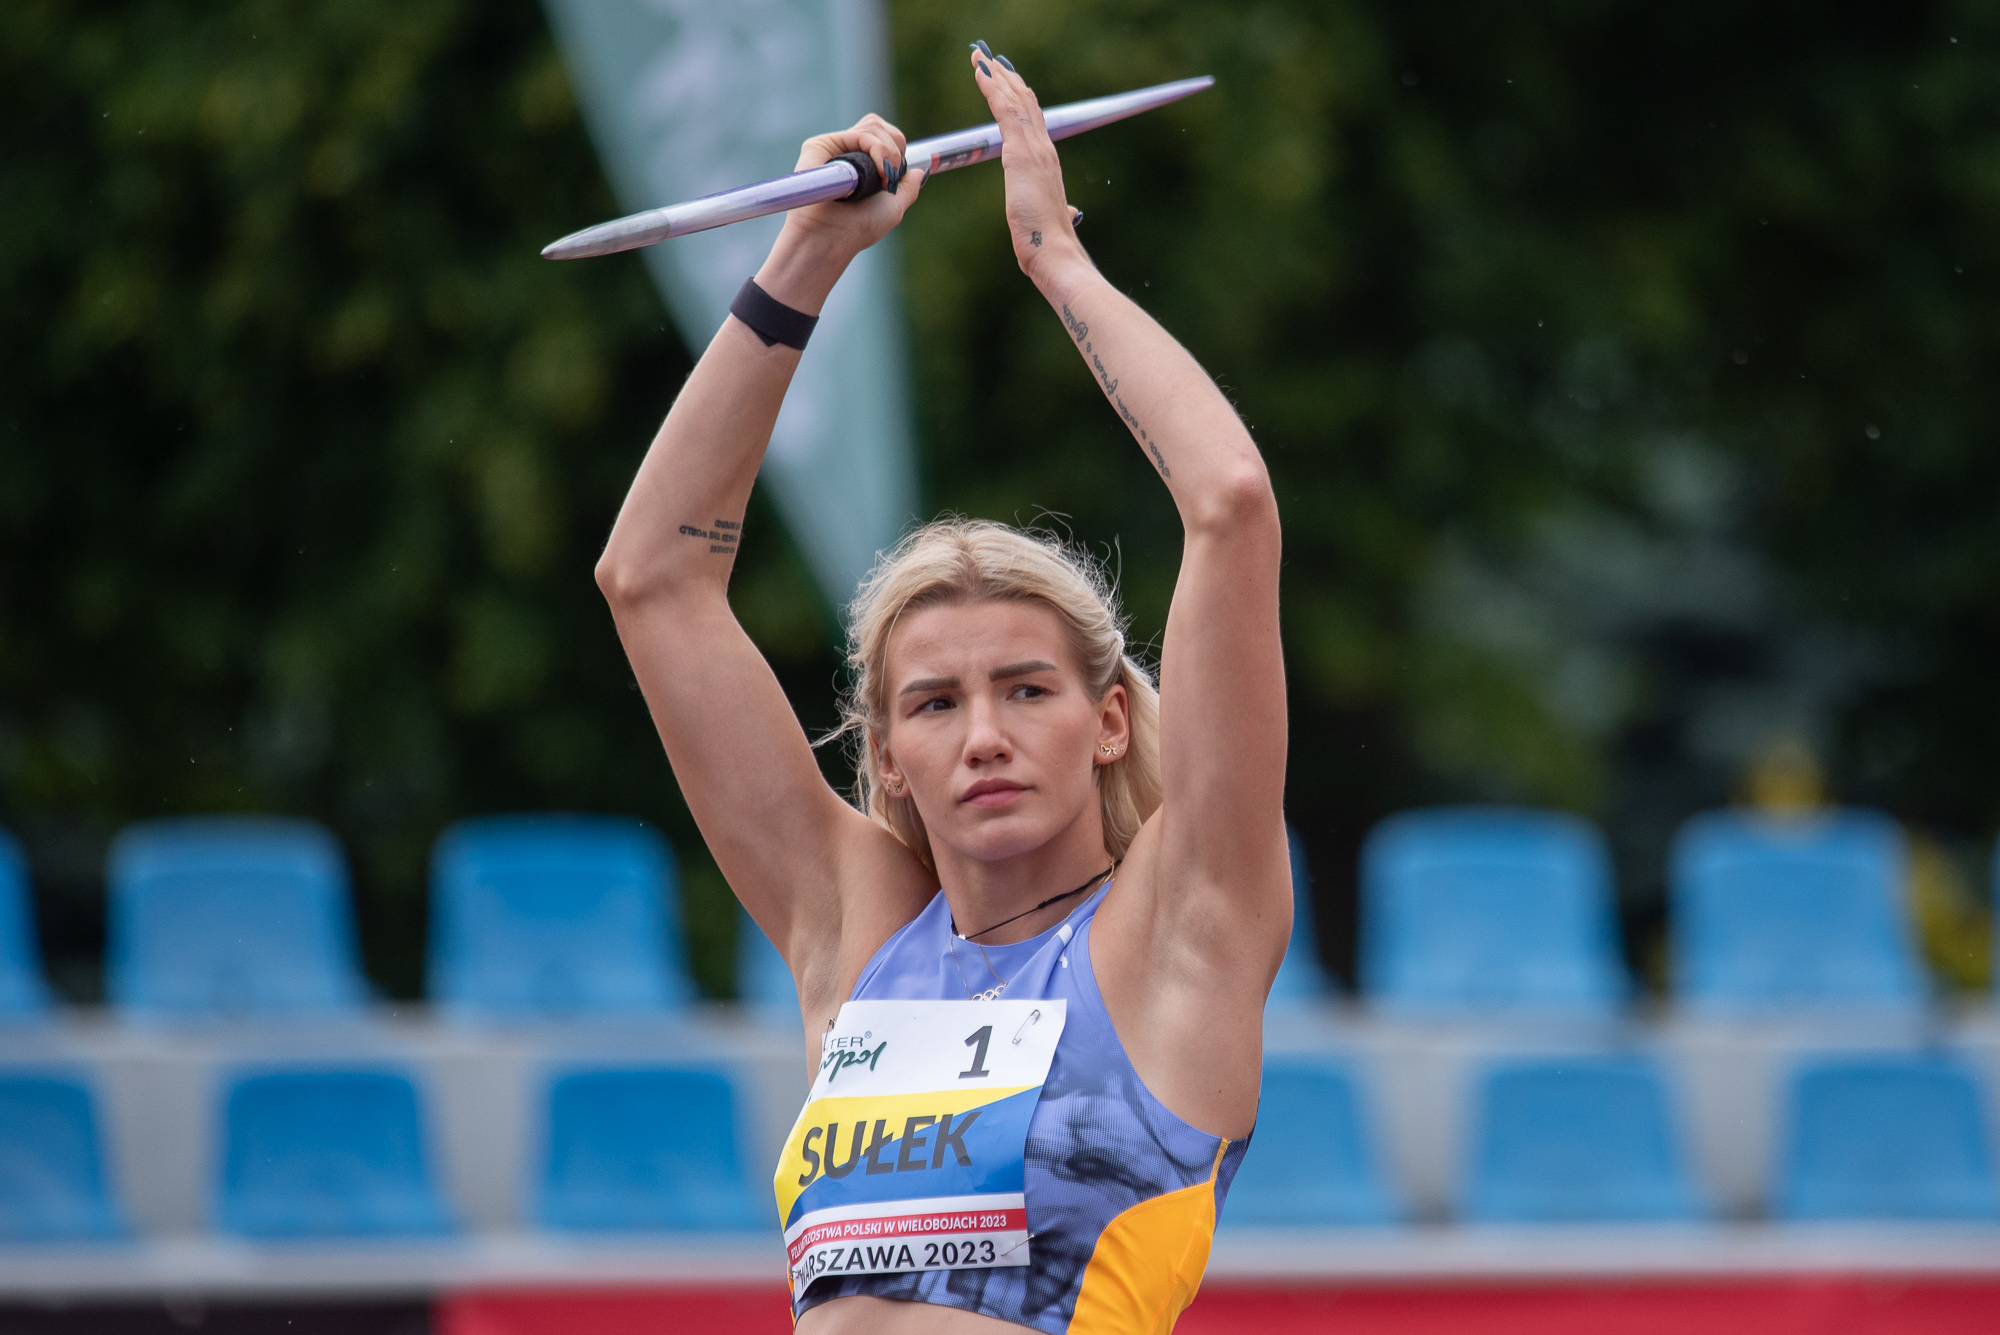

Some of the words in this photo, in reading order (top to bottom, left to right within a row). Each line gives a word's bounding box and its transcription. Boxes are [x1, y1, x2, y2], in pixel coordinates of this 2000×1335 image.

[679, 525, 708, 539] WORLD
[830, 1036, 863, 1049] TER
[958, 1025, 993, 1079] 1
[798, 1111, 982, 1188] SUŁEK
[844, 1222, 881, 1237] POLSKI
[884, 1221, 896, 1233] W
[897, 1216, 977, 1232] WIELOBOJACH
[979, 1214, 1007, 1229] 2023
[799, 1244, 916, 1289] WARSZAWA
[924, 1240, 996, 1267] 2023
